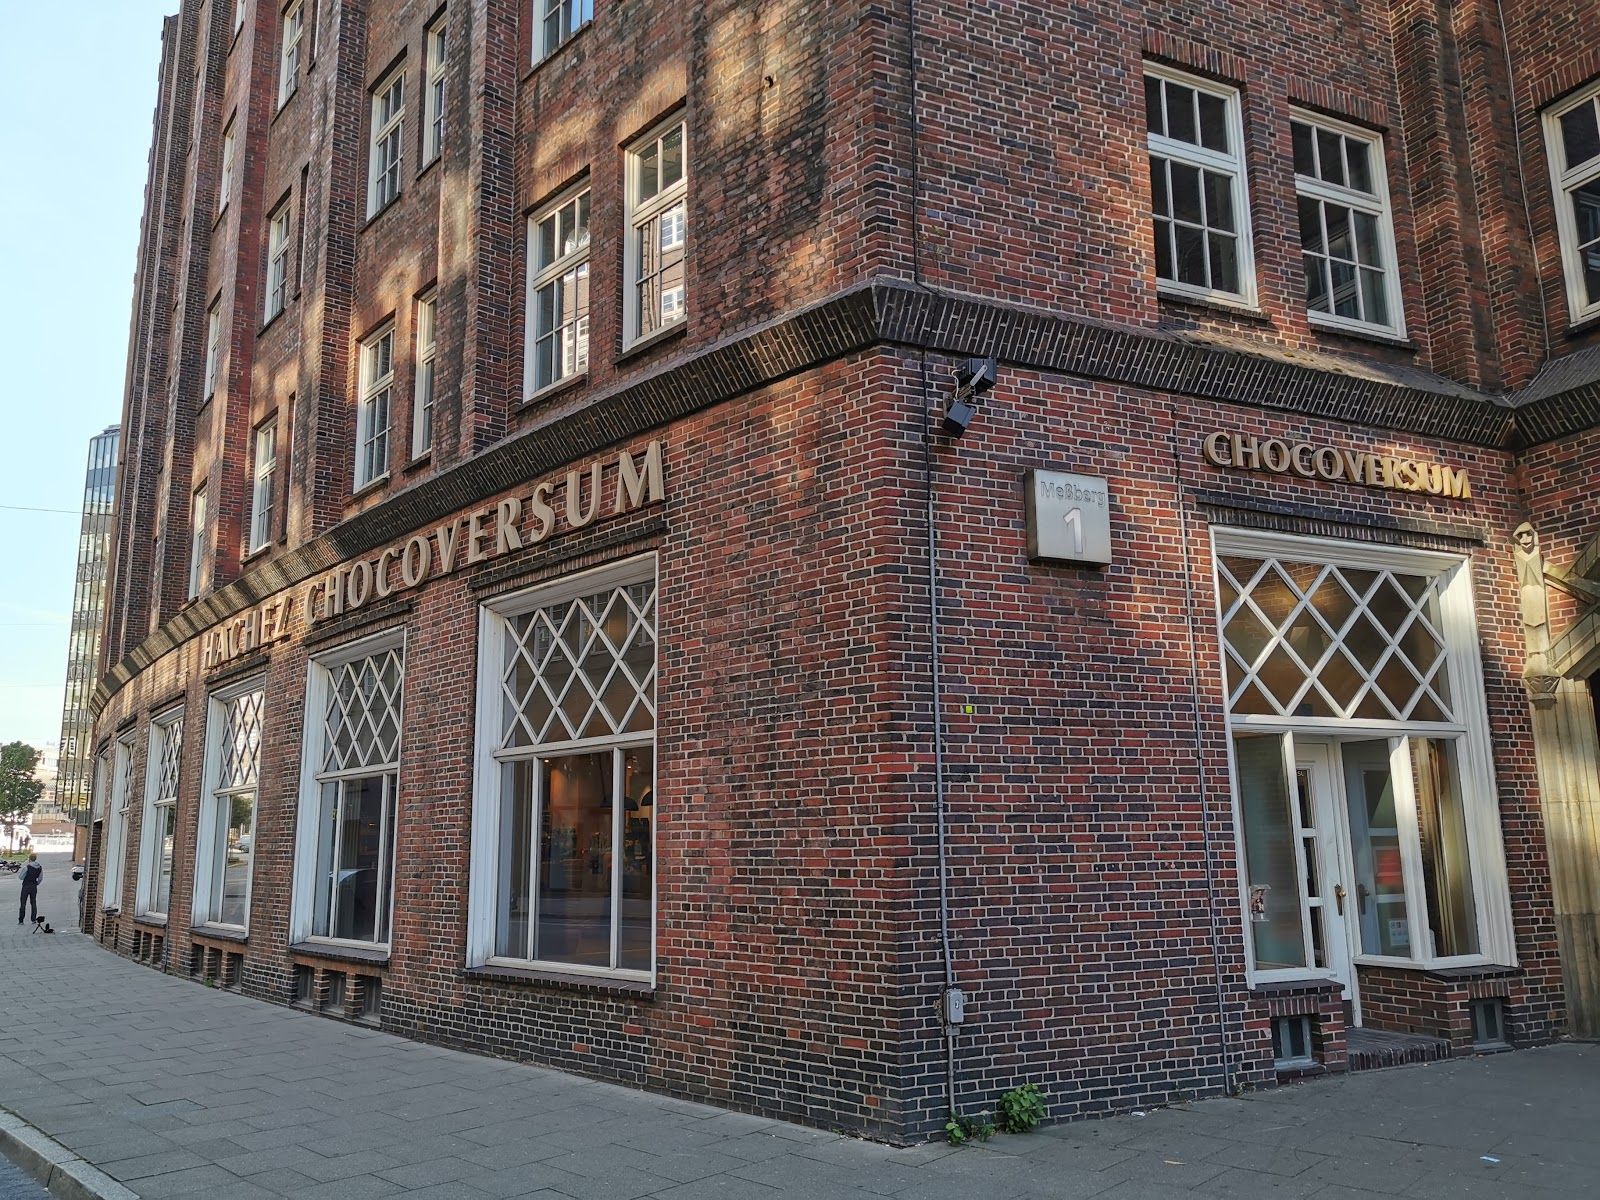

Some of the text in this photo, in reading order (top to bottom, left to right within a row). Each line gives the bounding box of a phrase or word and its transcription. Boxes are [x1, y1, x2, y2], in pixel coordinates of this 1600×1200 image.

[1203, 431, 1471, 499] CHOCOVERSUM
[1040, 481, 1106, 507] Meßberg
[203, 440, 666, 670] HACHEZ CHOCOVERSUM
[1063, 507, 1084, 554] 1
